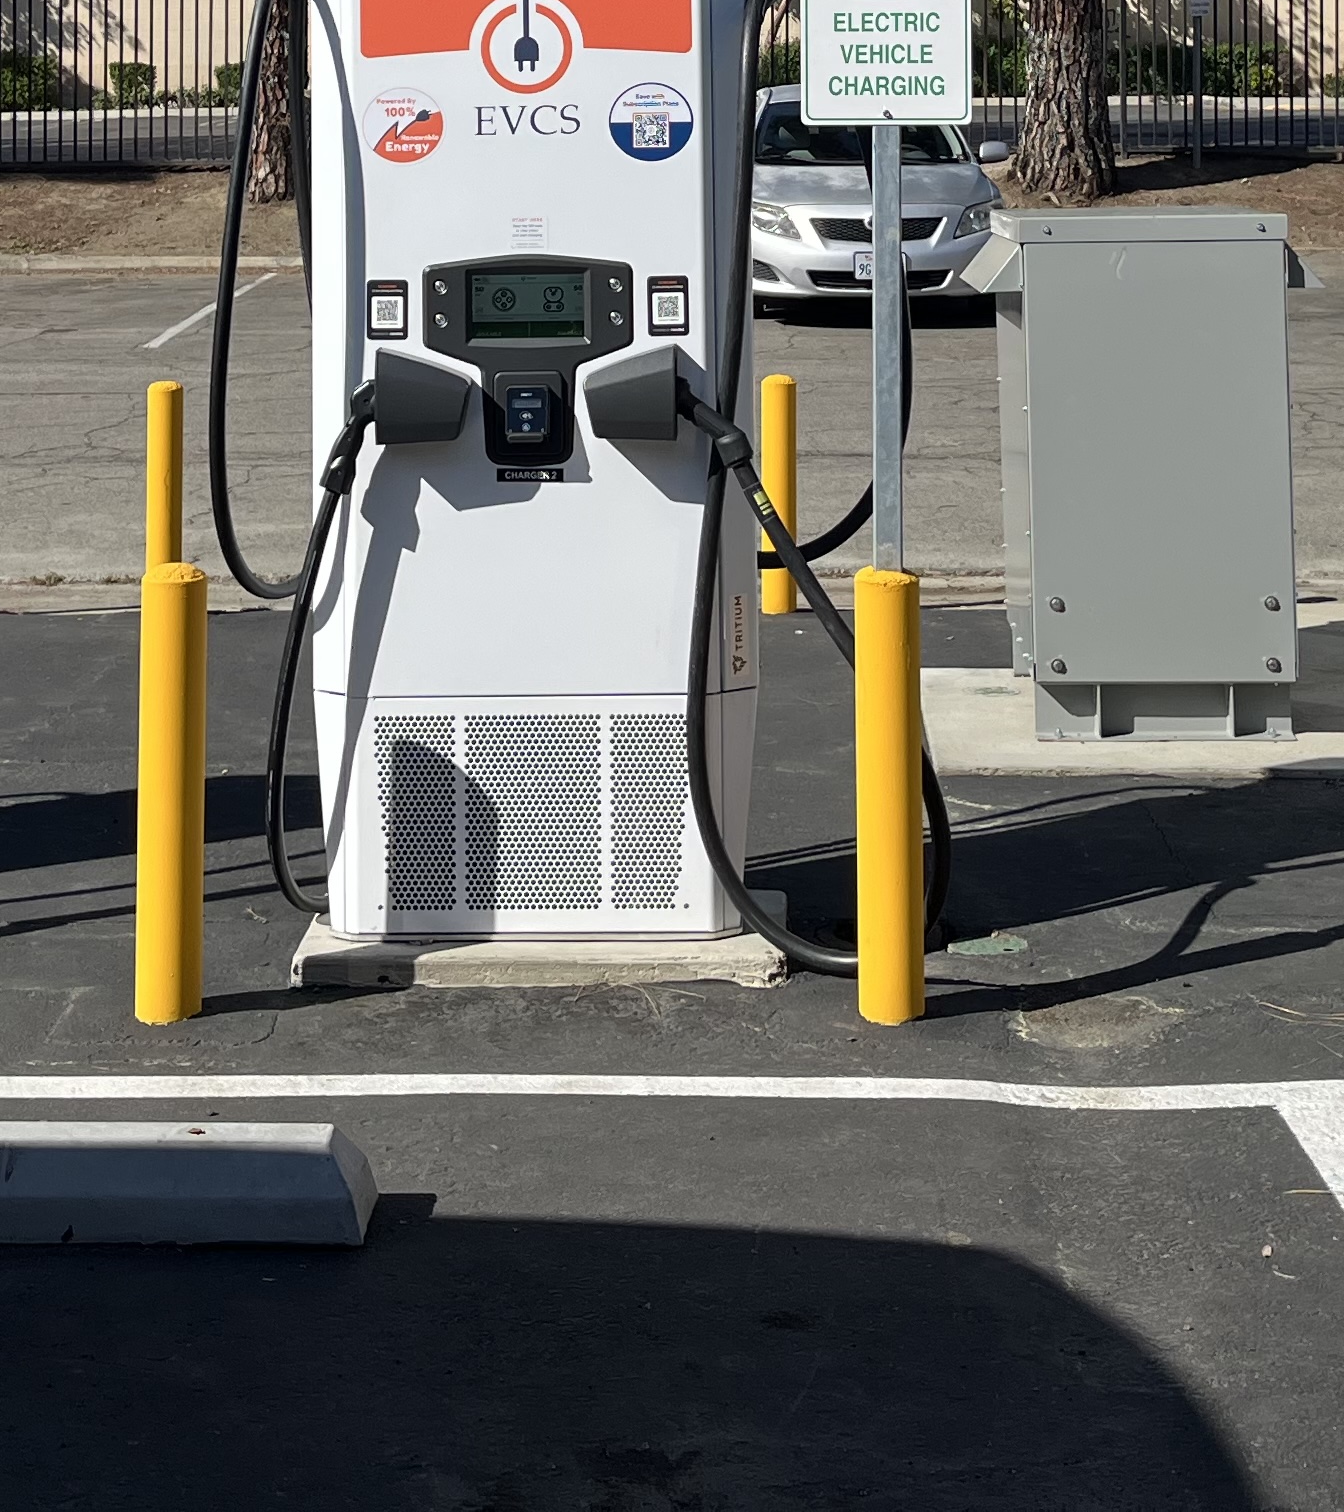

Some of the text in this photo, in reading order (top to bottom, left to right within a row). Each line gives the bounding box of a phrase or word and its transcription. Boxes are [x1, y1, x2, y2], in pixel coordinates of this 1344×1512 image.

[833, 11, 941, 33] ELECTRIC
[840, 44, 933, 64] VEHICLE
[828, 75, 946, 96] CHARGING
[384, 106, 416, 118] 100%
[474, 103, 581, 136] EVCS
[384, 140, 430, 154] Energy
[504, 470, 558, 480] CHARGER 2
[734, 594, 744, 652] TRITIUM
